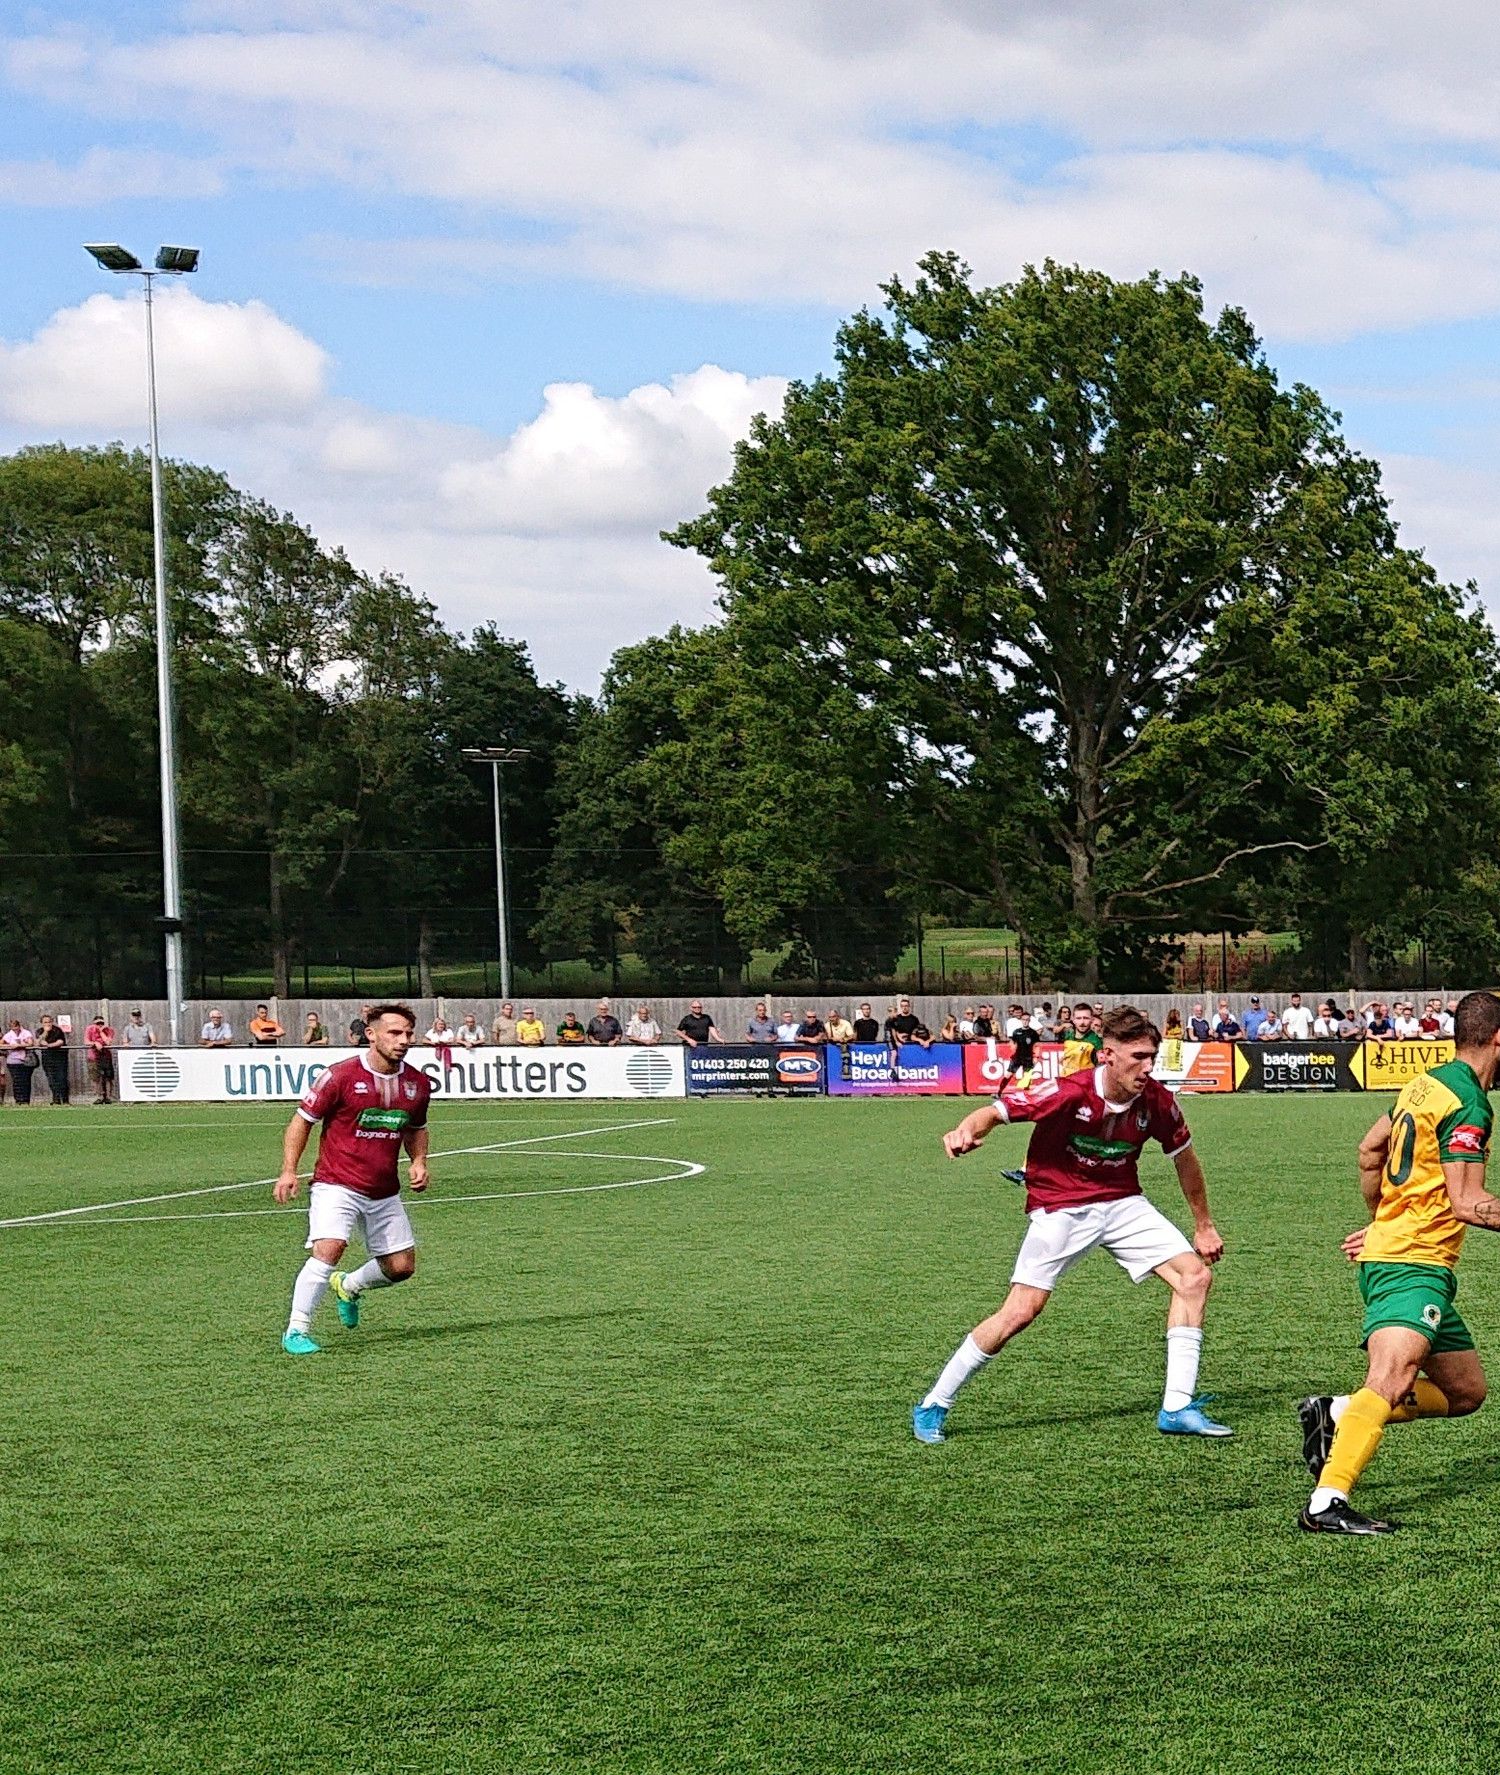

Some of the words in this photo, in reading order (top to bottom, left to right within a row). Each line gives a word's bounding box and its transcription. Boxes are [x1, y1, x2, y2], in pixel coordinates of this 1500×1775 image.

[851, 1051, 888, 1066] Hey!
[1263, 1052, 1335, 1067] badgerbee
[1389, 1047, 1448, 1065] HIVE
[691, 1059, 725, 1069] 01403
[726, 1059, 747, 1069] 250
[748, 1059, 769, 1069] 420
[421, 1055, 587, 1094] shutters
[691, 1071, 769, 1082] mrprinters.com
[1263, 1066, 1336, 1081] DESIGN
